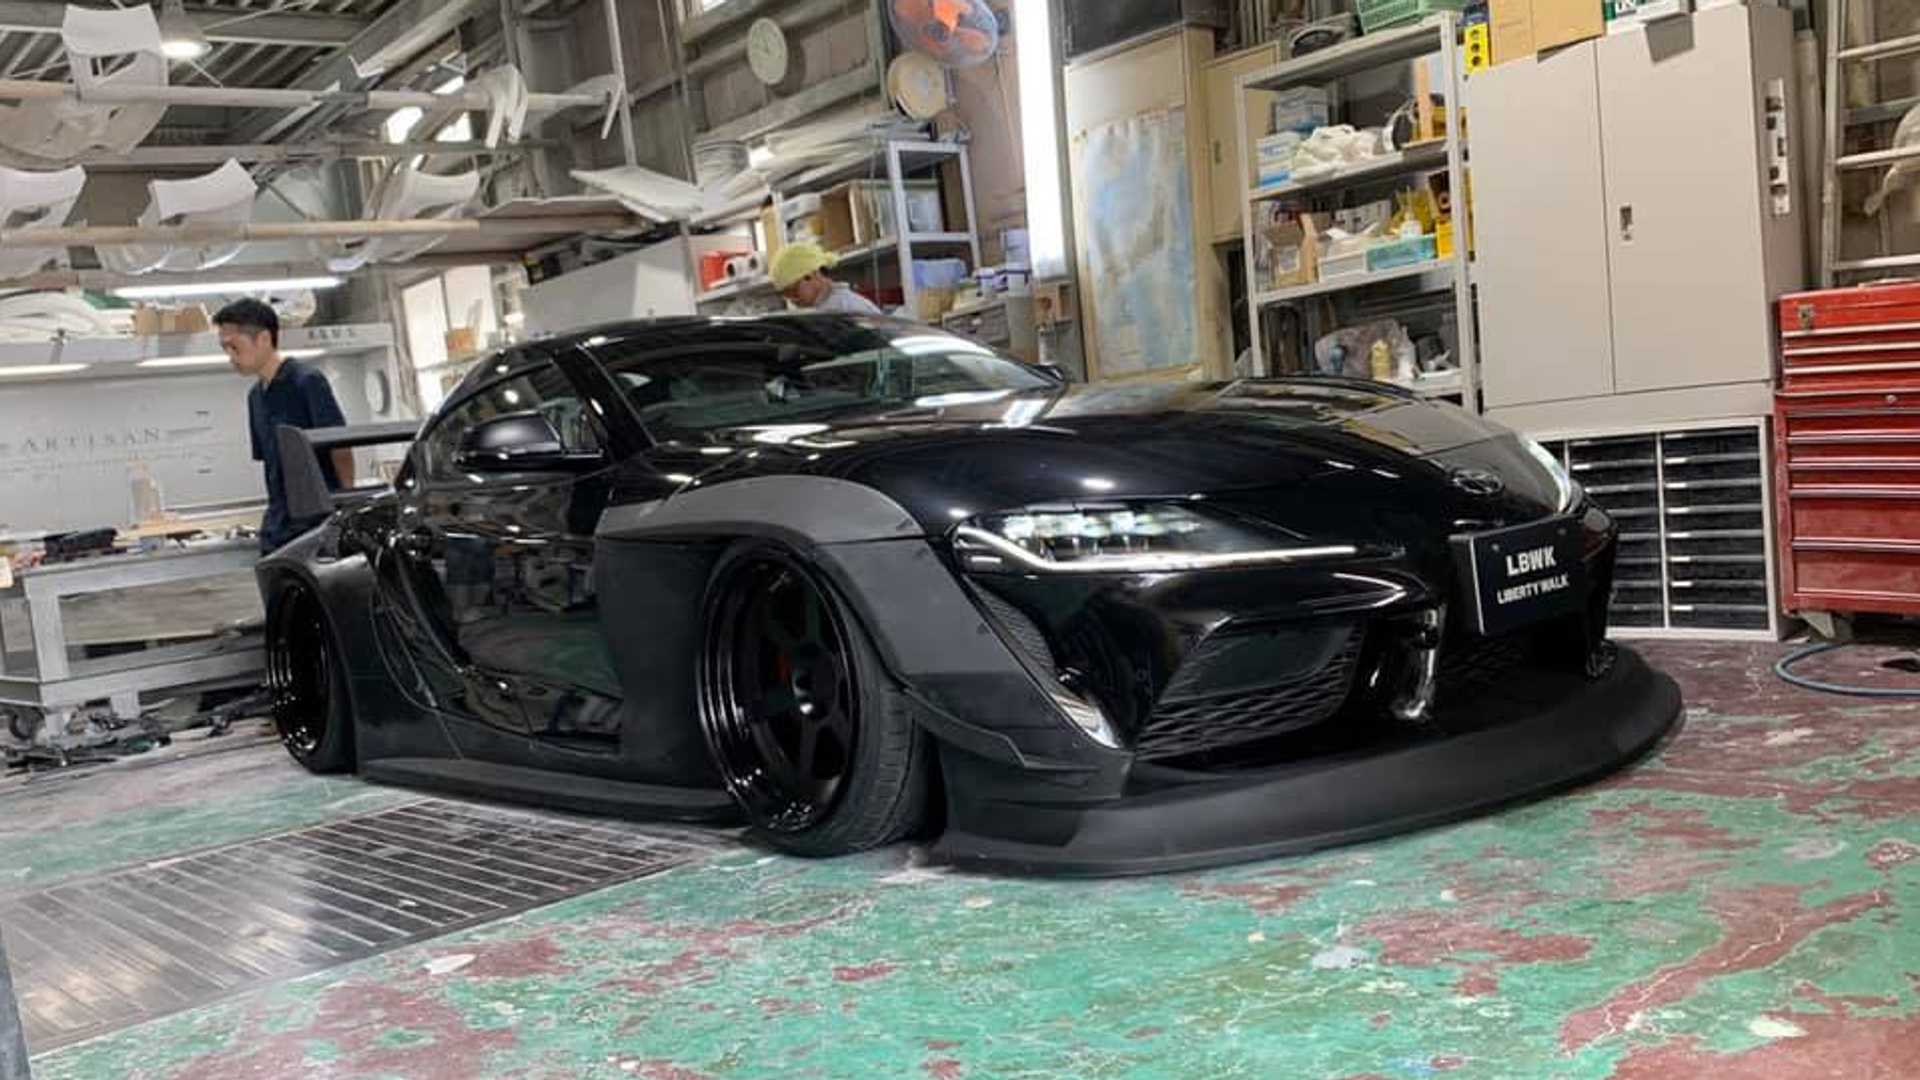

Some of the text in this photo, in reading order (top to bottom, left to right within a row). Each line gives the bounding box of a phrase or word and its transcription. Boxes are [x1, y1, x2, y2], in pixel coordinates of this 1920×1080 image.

[24, 427, 160, 450] ARTISAN
[1506, 546, 1556, 575] LBWK
[1497, 572, 1568, 604] LIBERTY WALK
